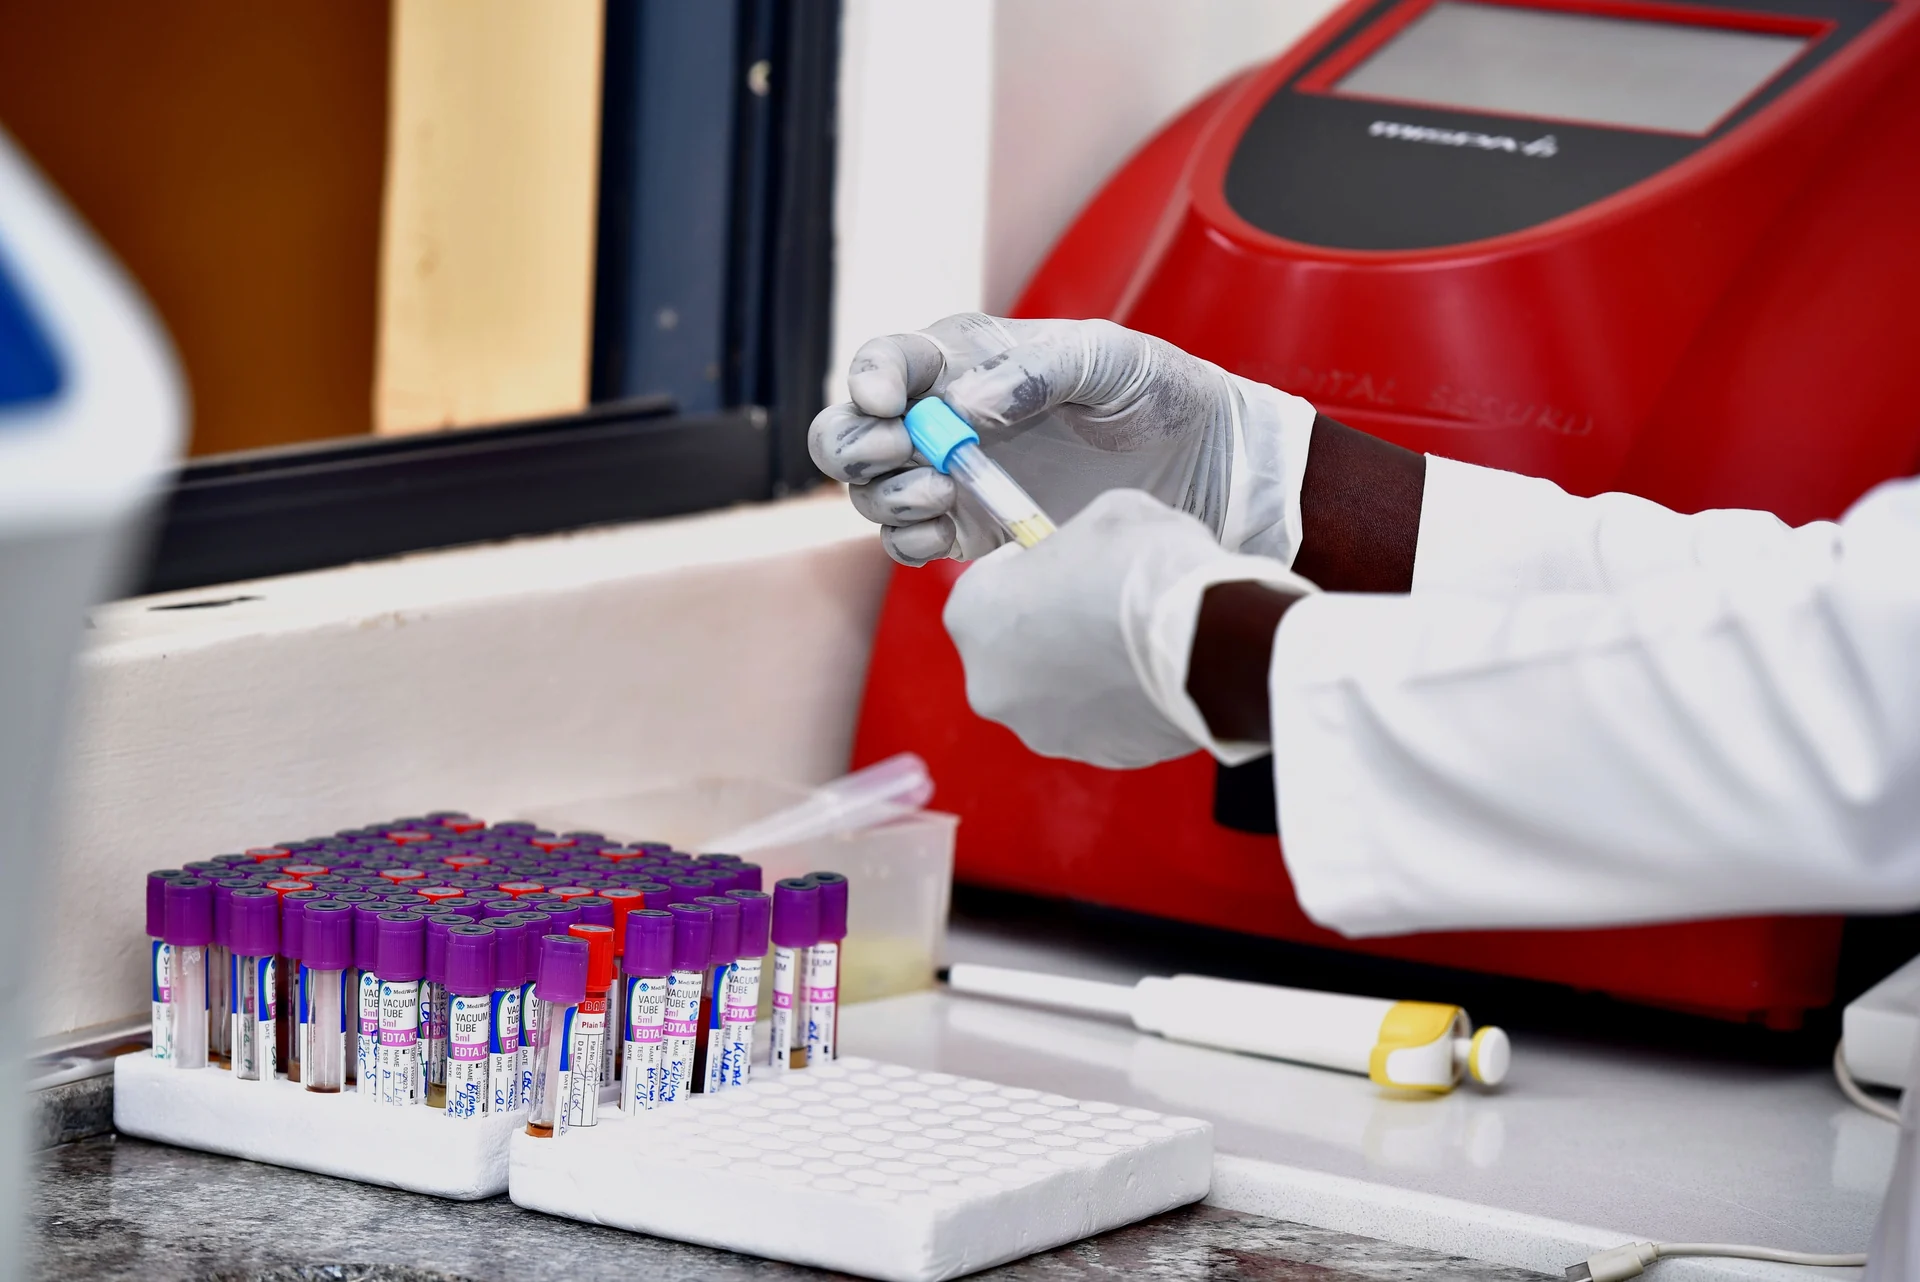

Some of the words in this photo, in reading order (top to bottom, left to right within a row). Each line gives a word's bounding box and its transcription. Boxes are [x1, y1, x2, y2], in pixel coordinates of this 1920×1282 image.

[666, 987, 700, 999] VACUUM
[728, 984, 748, 994] TUBE
[383, 998, 416, 1009] VACUUM
[666, 998, 686, 1008] TUBE
[383, 1009, 403, 1018] TUBE
[638, 1005, 659, 1015] TUBE
[664, 1008, 679, 1018] 5ml
[455, 1011, 488, 1022] VACUUM
[637, 1015, 653, 1024] 5ml
[382, 1019, 397, 1028] 5ml
[455, 1023, 477, 1033] TUBE
[581, 1021, 599, 1029] Plain
[455, 1033, 470, 1042] 5ml
[576, 1040, 585, 1063] Date:
